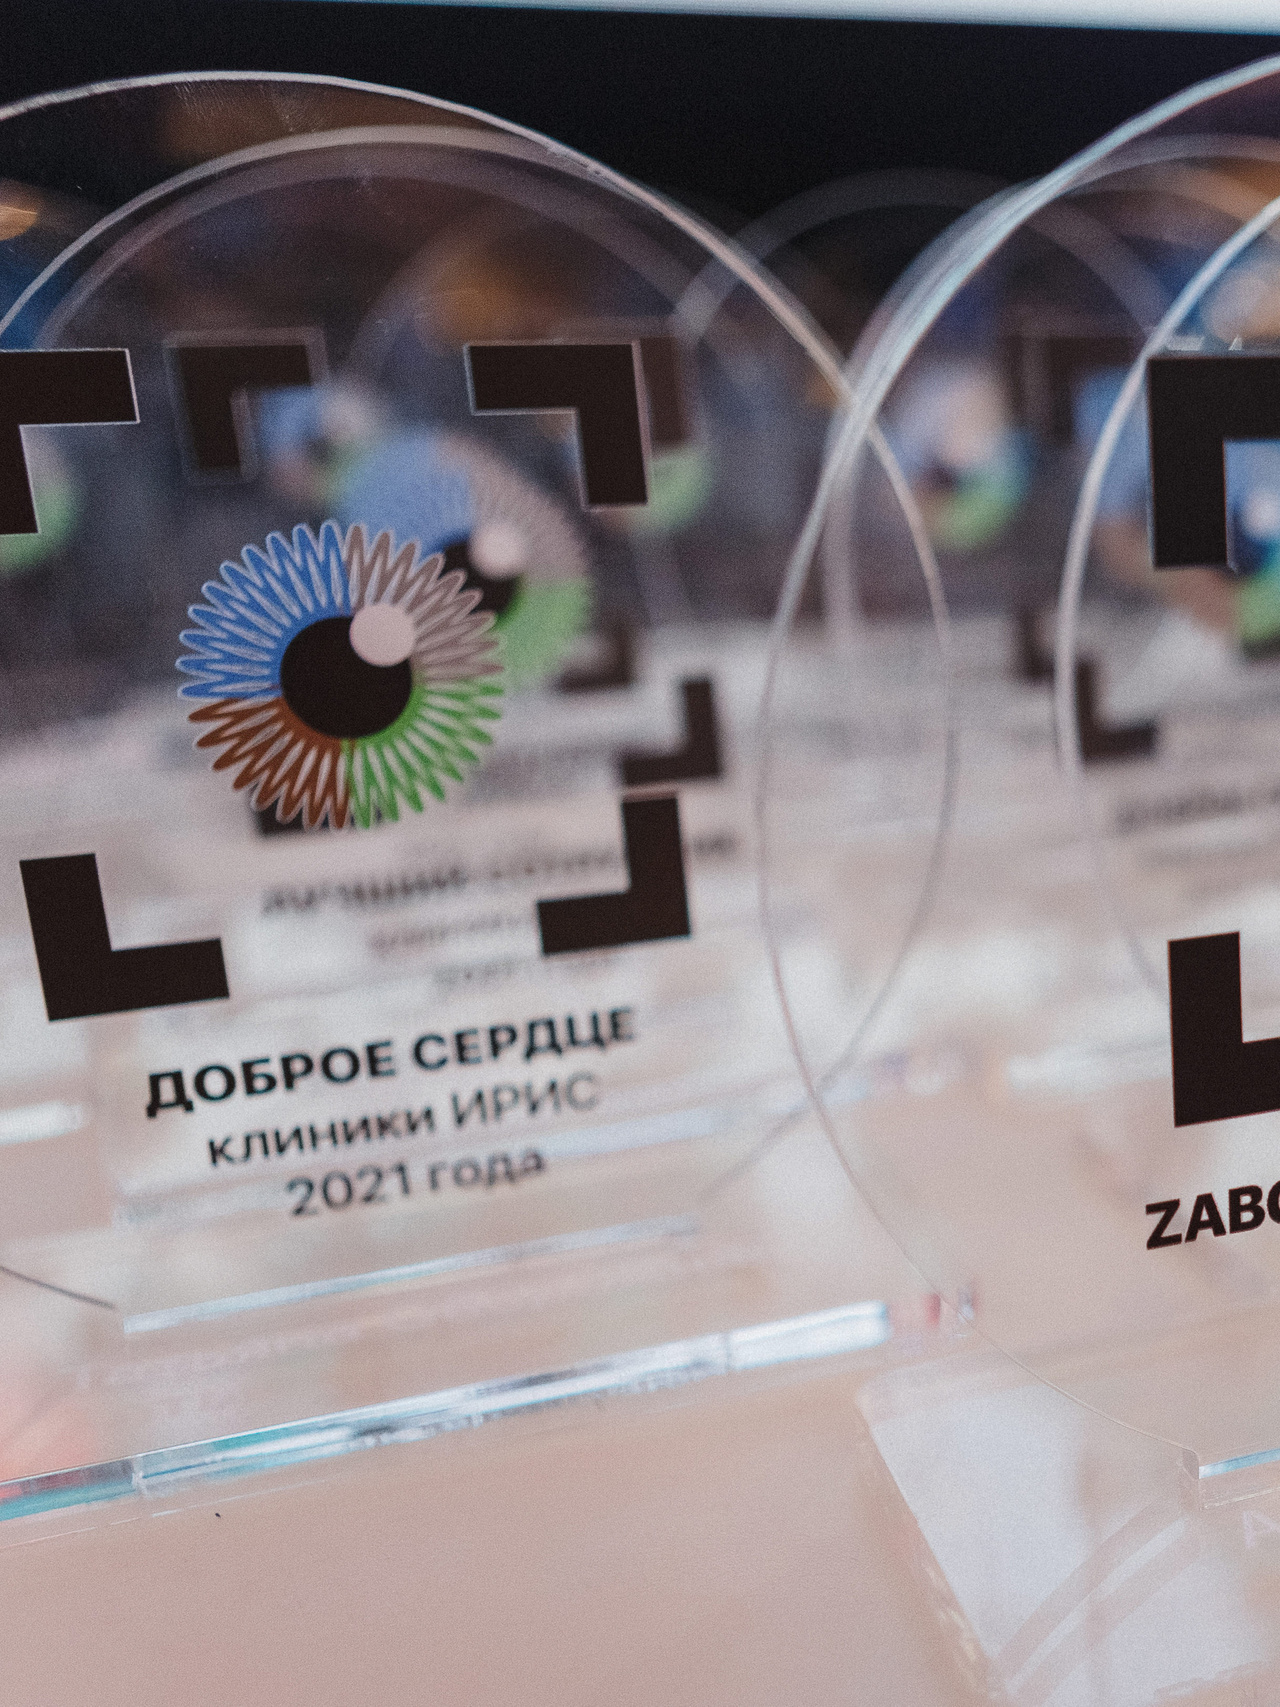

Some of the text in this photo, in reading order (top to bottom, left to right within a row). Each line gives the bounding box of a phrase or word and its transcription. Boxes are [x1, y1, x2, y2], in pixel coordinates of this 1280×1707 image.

[145, 1006, 637, 1118] ДОБРОЕ СЕРДЦЕ
[207, 1071, 601, 1168] клиники ИРИС
[286, 1145, 547, 1218] 2021 года
